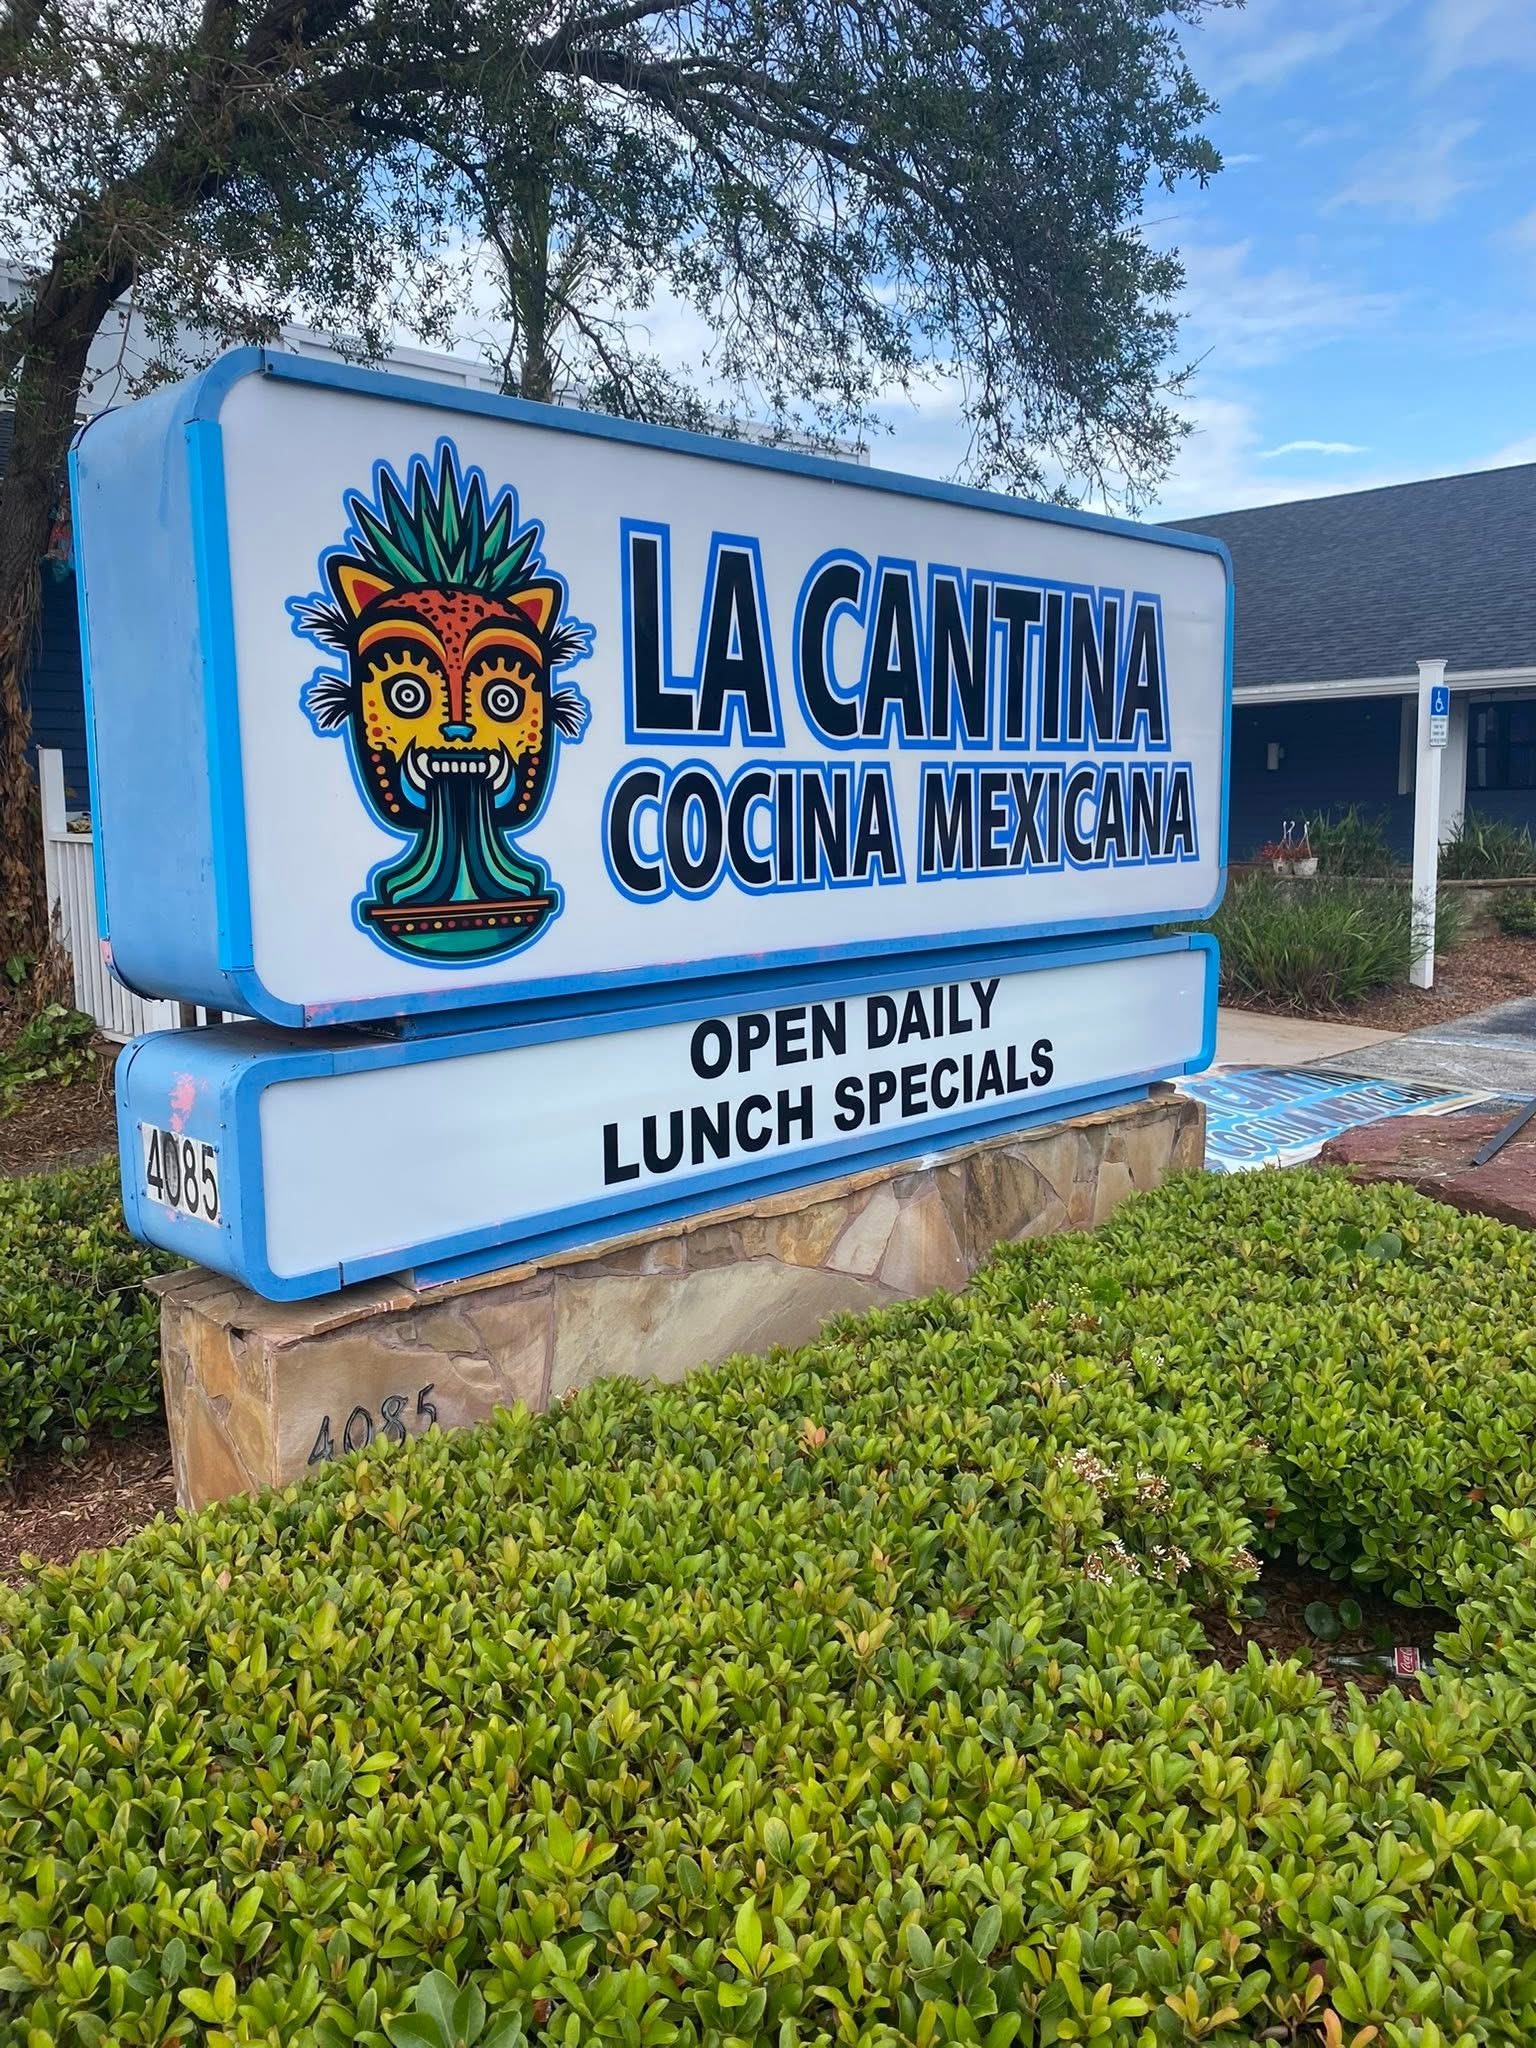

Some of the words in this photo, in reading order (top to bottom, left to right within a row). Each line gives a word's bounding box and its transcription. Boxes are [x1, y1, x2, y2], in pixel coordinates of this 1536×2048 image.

[631, 535, 773, 734] LA
[801, 563, 1165, 743] CANTINA
[609, 770, 898, 893] COCINA
[921, 769, 1195, 876] MEXICANA
[690, 1001, 847, 1080] OPEN
[866, 978, 1001, 1050] DAILY
[602, 1084, 813, 1185] LUNCH
[833, 1038, 1055, 1131] SPECIALS
[146, 1128, 218, 1222] 4085
[307, 1382, 437, 1466] 4085
